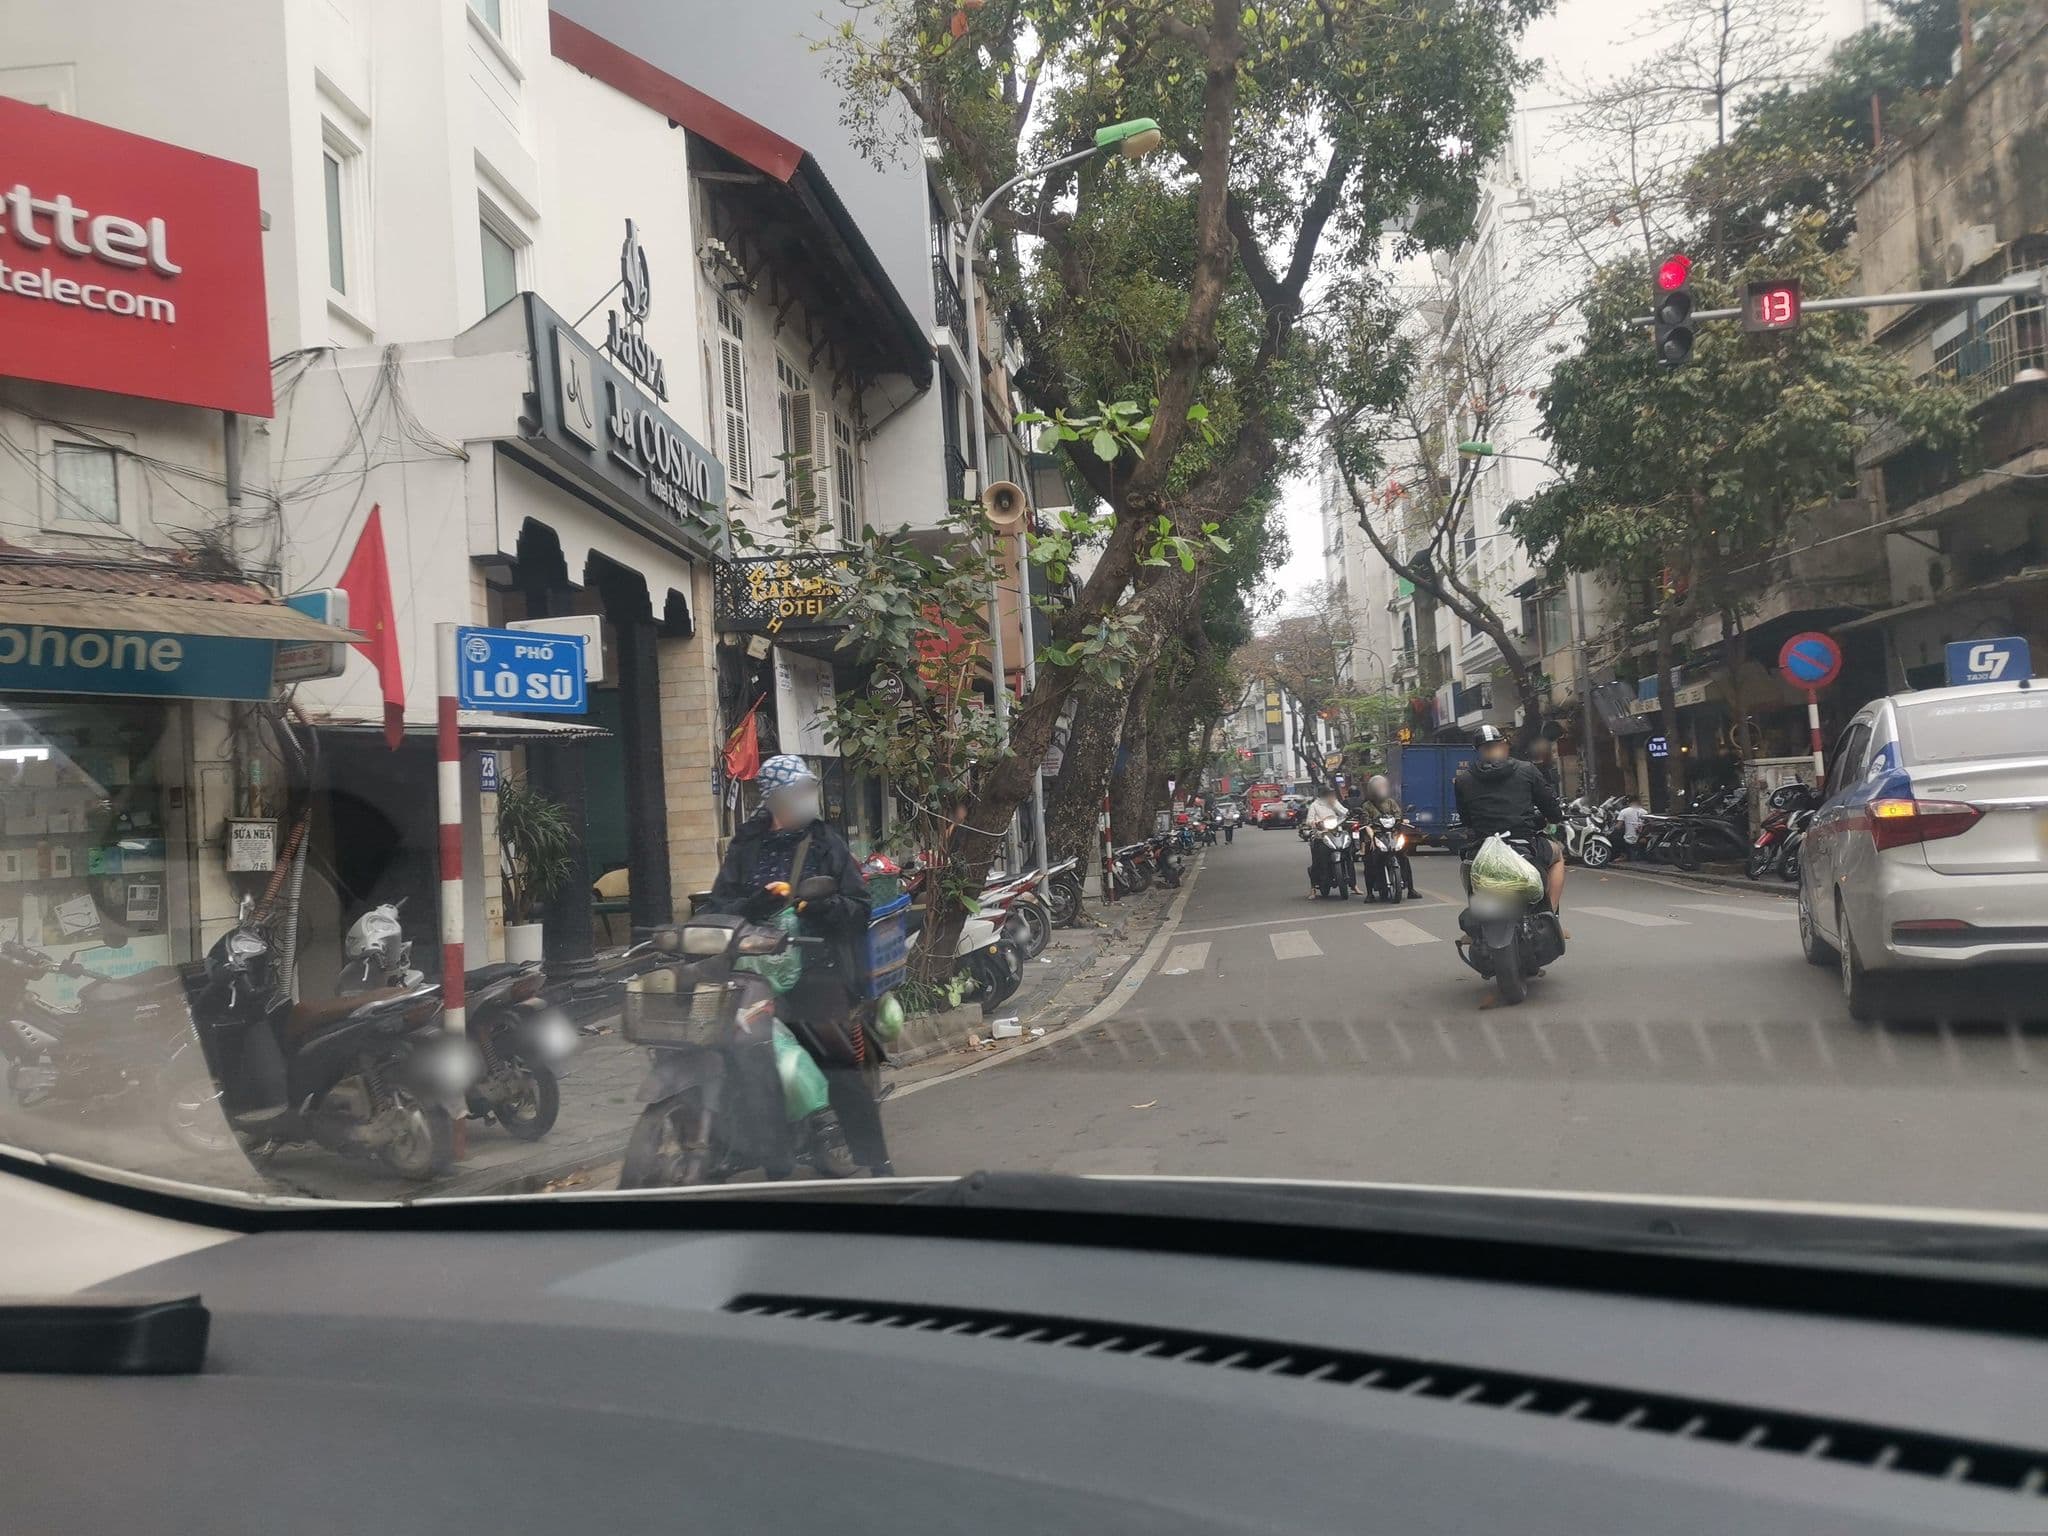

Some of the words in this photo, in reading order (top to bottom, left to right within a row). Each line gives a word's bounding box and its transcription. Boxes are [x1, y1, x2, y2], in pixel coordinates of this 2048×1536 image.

[0, 184, 182, 275] ttel
[0, 260, 176, 323] telecom
[1763, 292, 1792, 321] 13
[639, 409, 711, 502] COSMO
[515, 643, 554, 660] PHỐ
[1969, 645, 2009, 679] G7
[473, 663, 518, 698] LÒ
[526, 669, 573, 700] SŨ
[481, 757, 494, 777] 23
